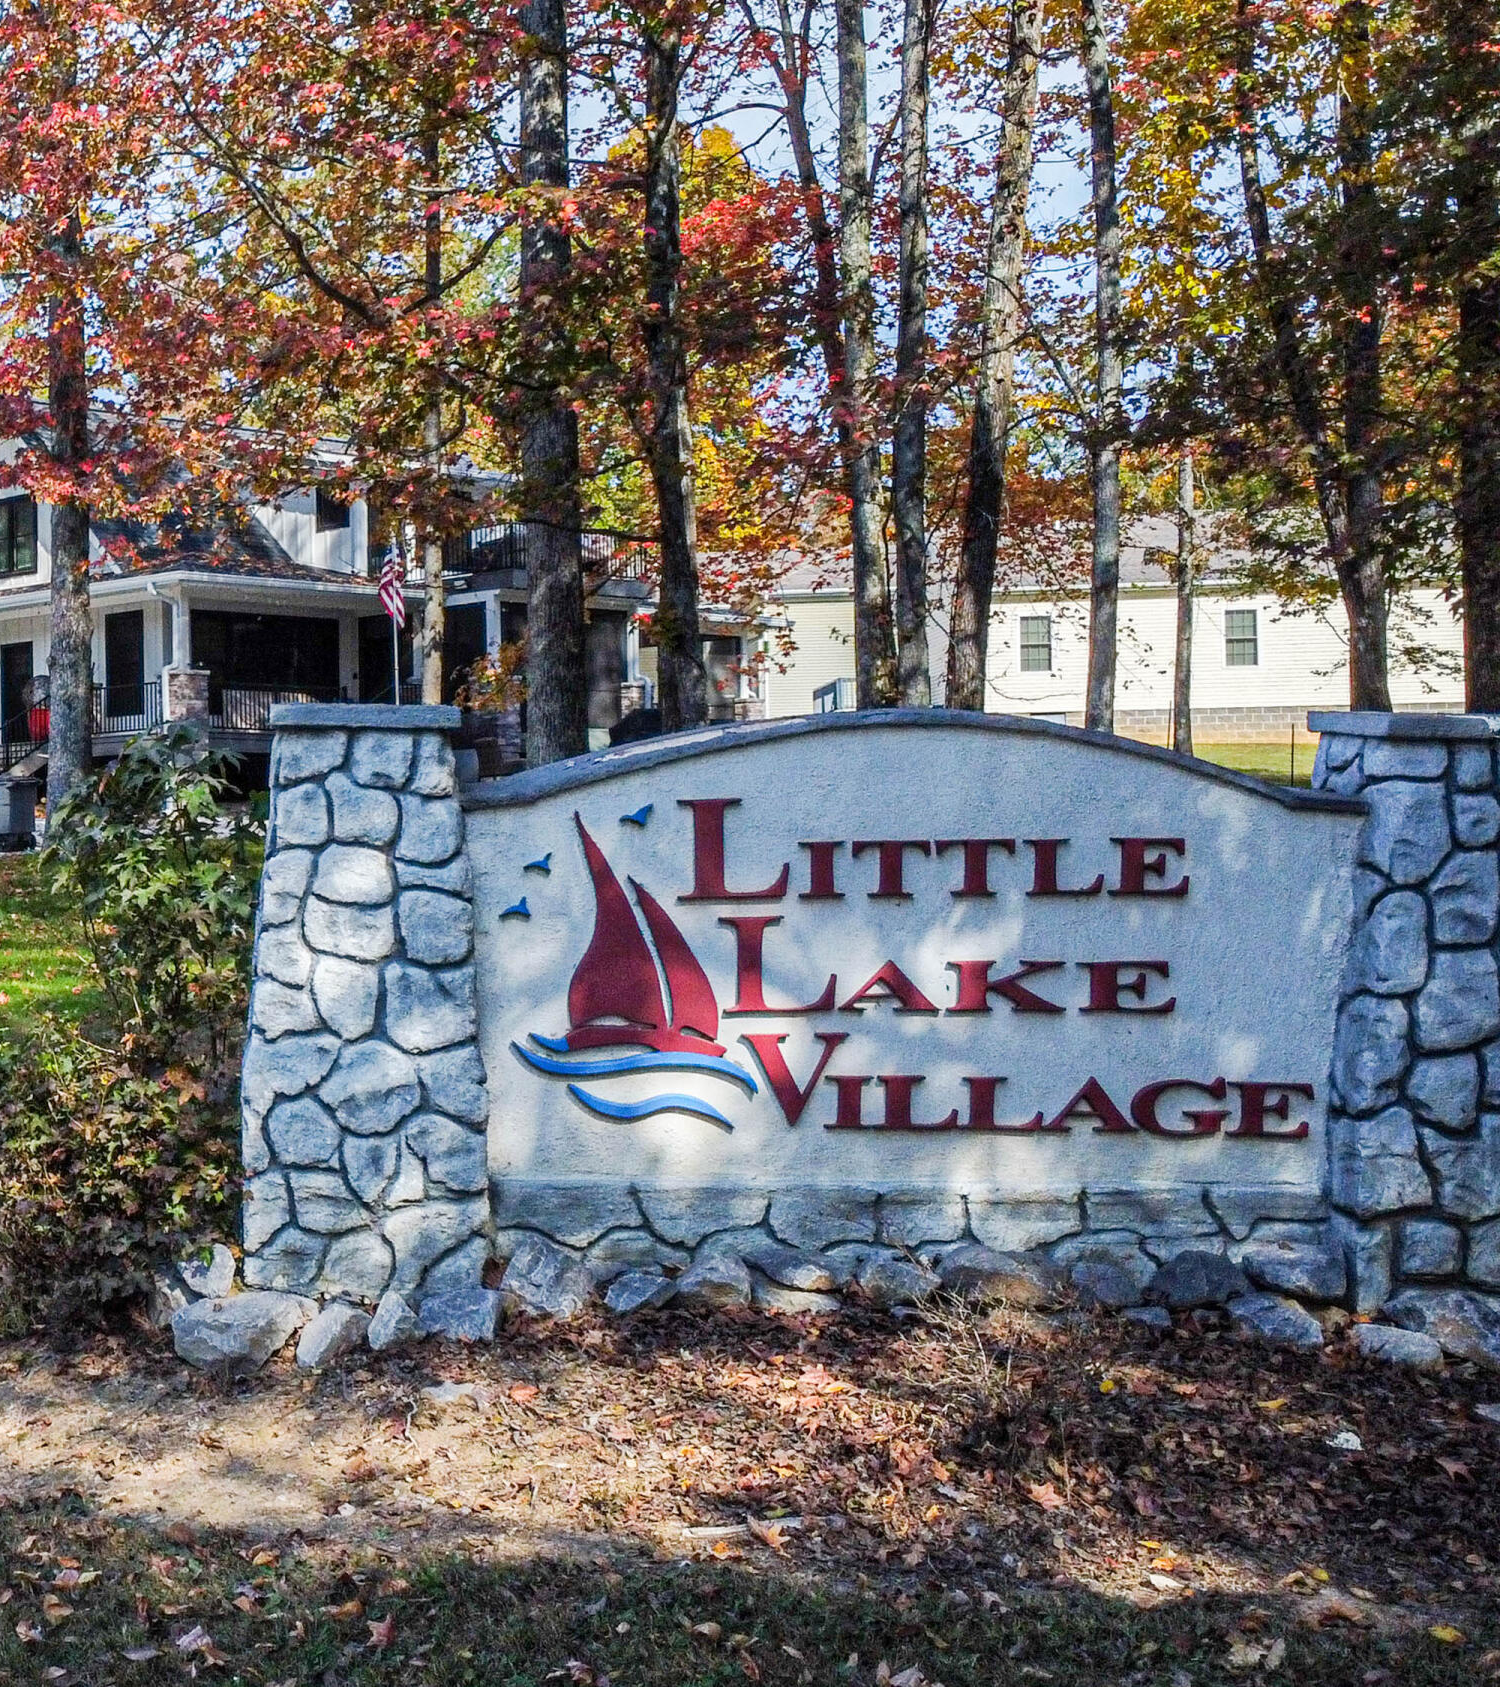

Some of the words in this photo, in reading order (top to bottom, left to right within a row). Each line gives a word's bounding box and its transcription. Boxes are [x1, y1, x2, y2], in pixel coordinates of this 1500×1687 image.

[677, 798, 1190, 902] LITTLE
[719, 915, 1177, 1015] LAKE
[740, 1032, 1314, 1138] VILLAGE
